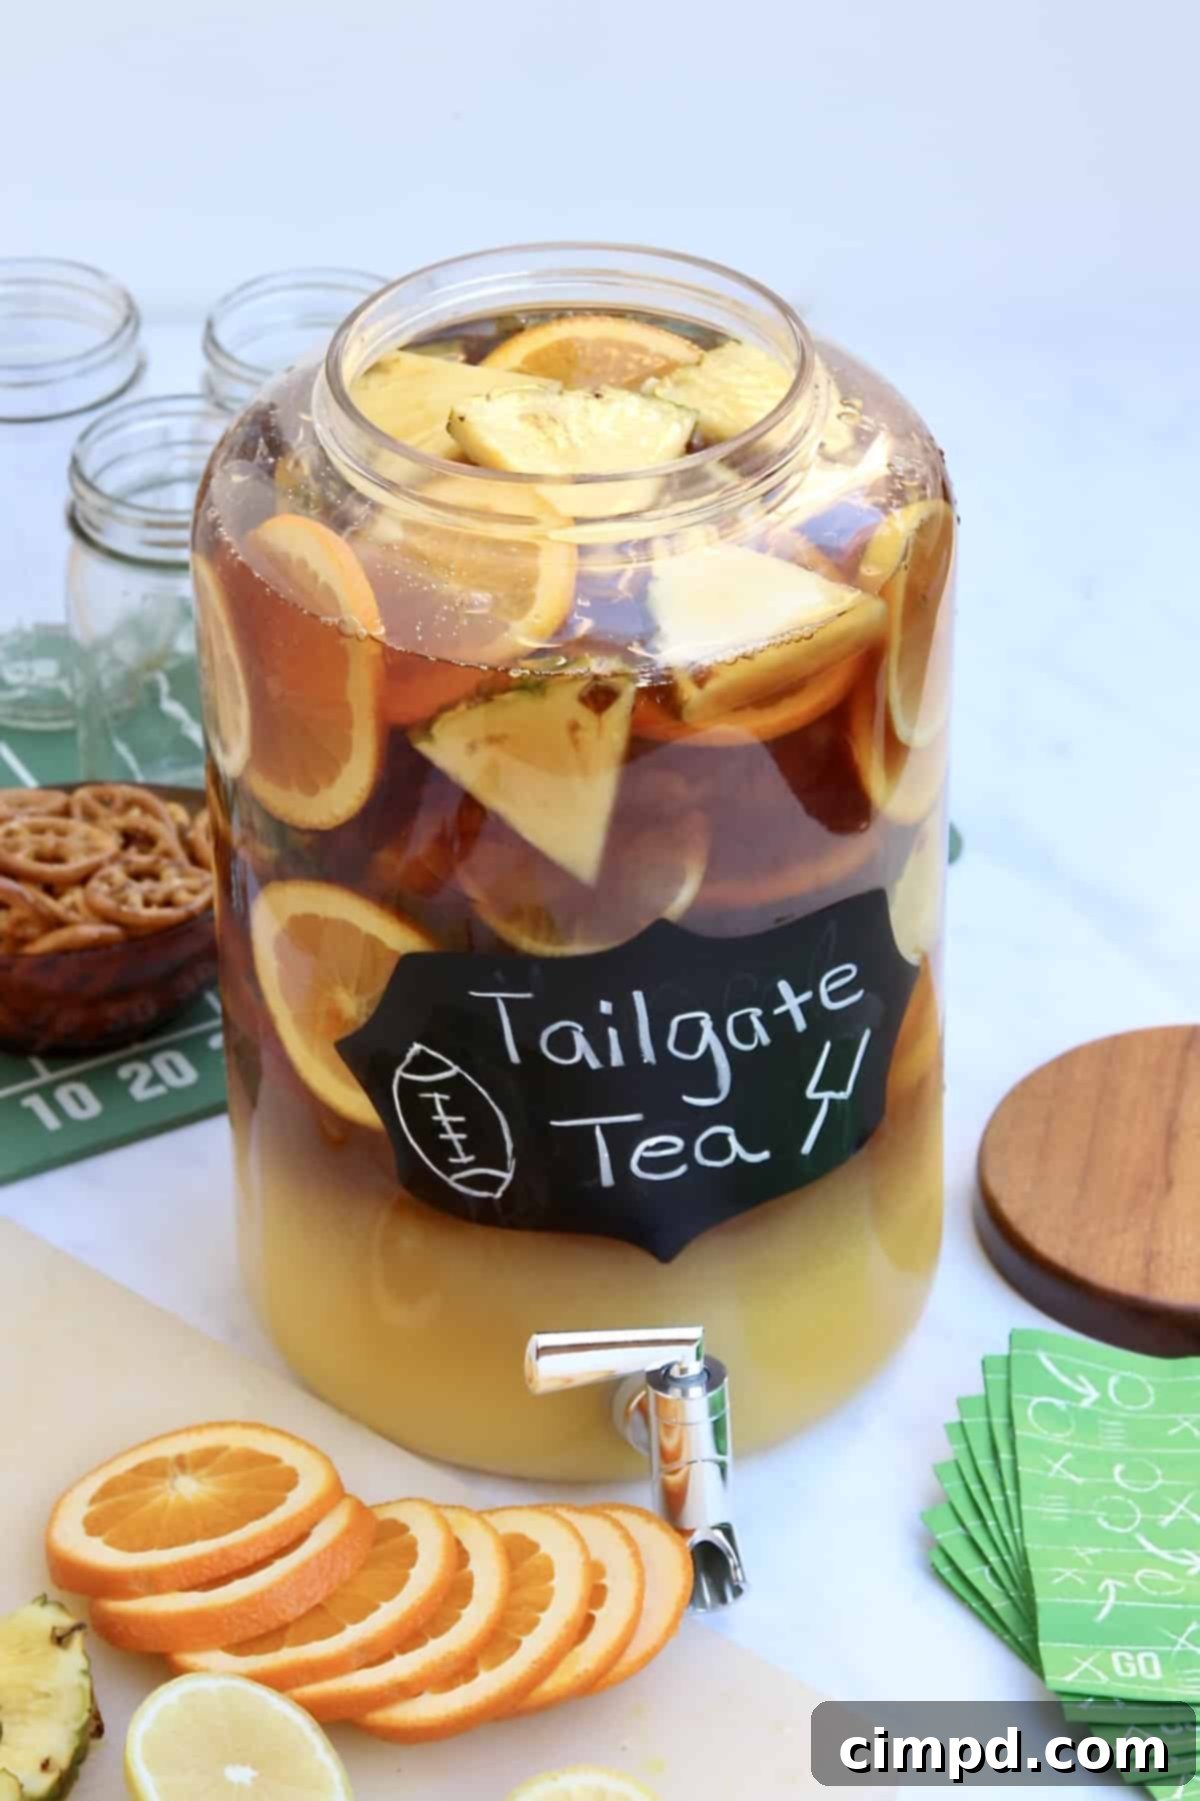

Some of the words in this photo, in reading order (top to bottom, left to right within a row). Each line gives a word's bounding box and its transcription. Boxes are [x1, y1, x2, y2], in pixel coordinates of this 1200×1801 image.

[468, 962, 866, 1106] Tailgate
[20, 1081, 102, 1131] 10
[117, 1051, 198, 1102] 20
[549, 1113, 770, 1187] Tea
[1111, 1650, 1163, 1680] GO
